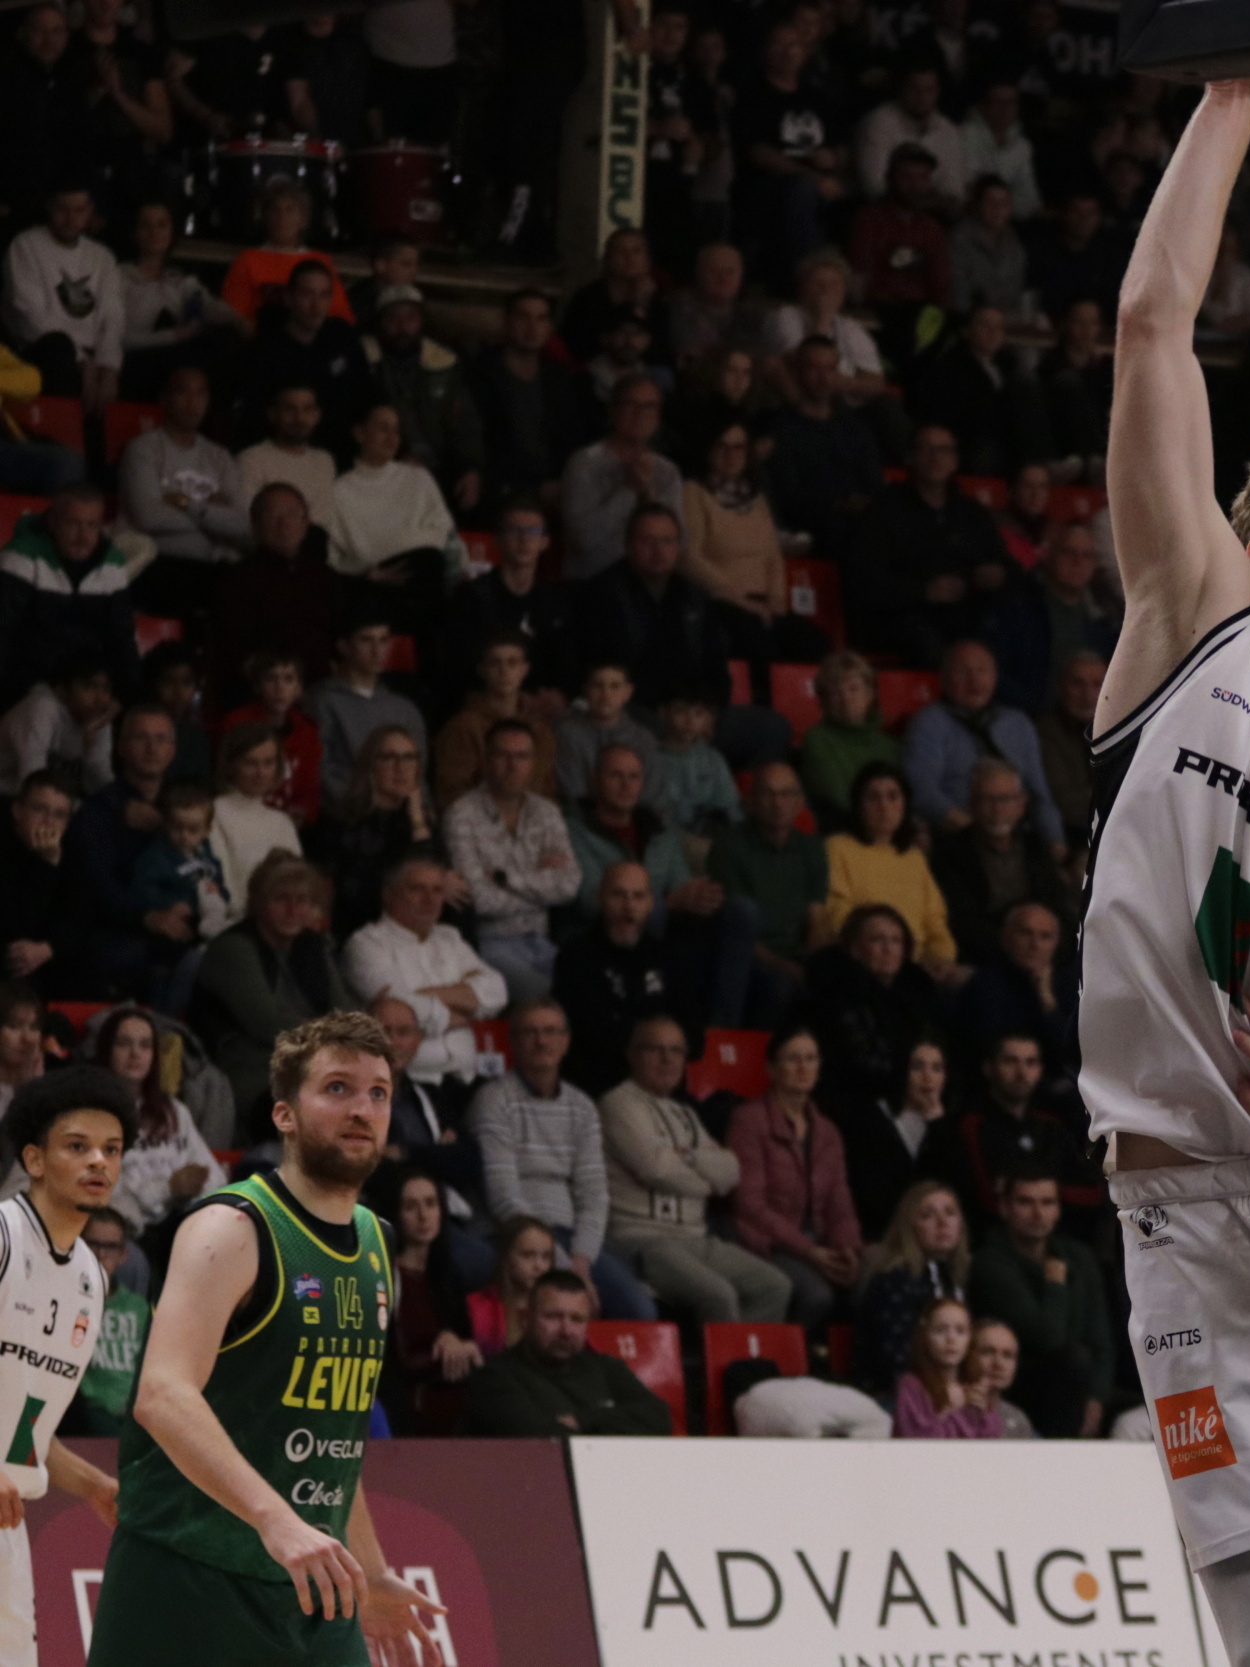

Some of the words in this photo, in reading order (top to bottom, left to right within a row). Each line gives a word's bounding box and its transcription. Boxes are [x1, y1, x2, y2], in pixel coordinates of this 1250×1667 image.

[43, 1300, 59, 1336] 3
[334, 1276, 364, 1330] 14
[1158, 1328, 1202, 1351] ATTIS
[281, 1355, 384, 1412] LEVIC
[1164, 1406, 1218, 1450] niké
[643, 1549, 1157, 1631] ADVANCE
